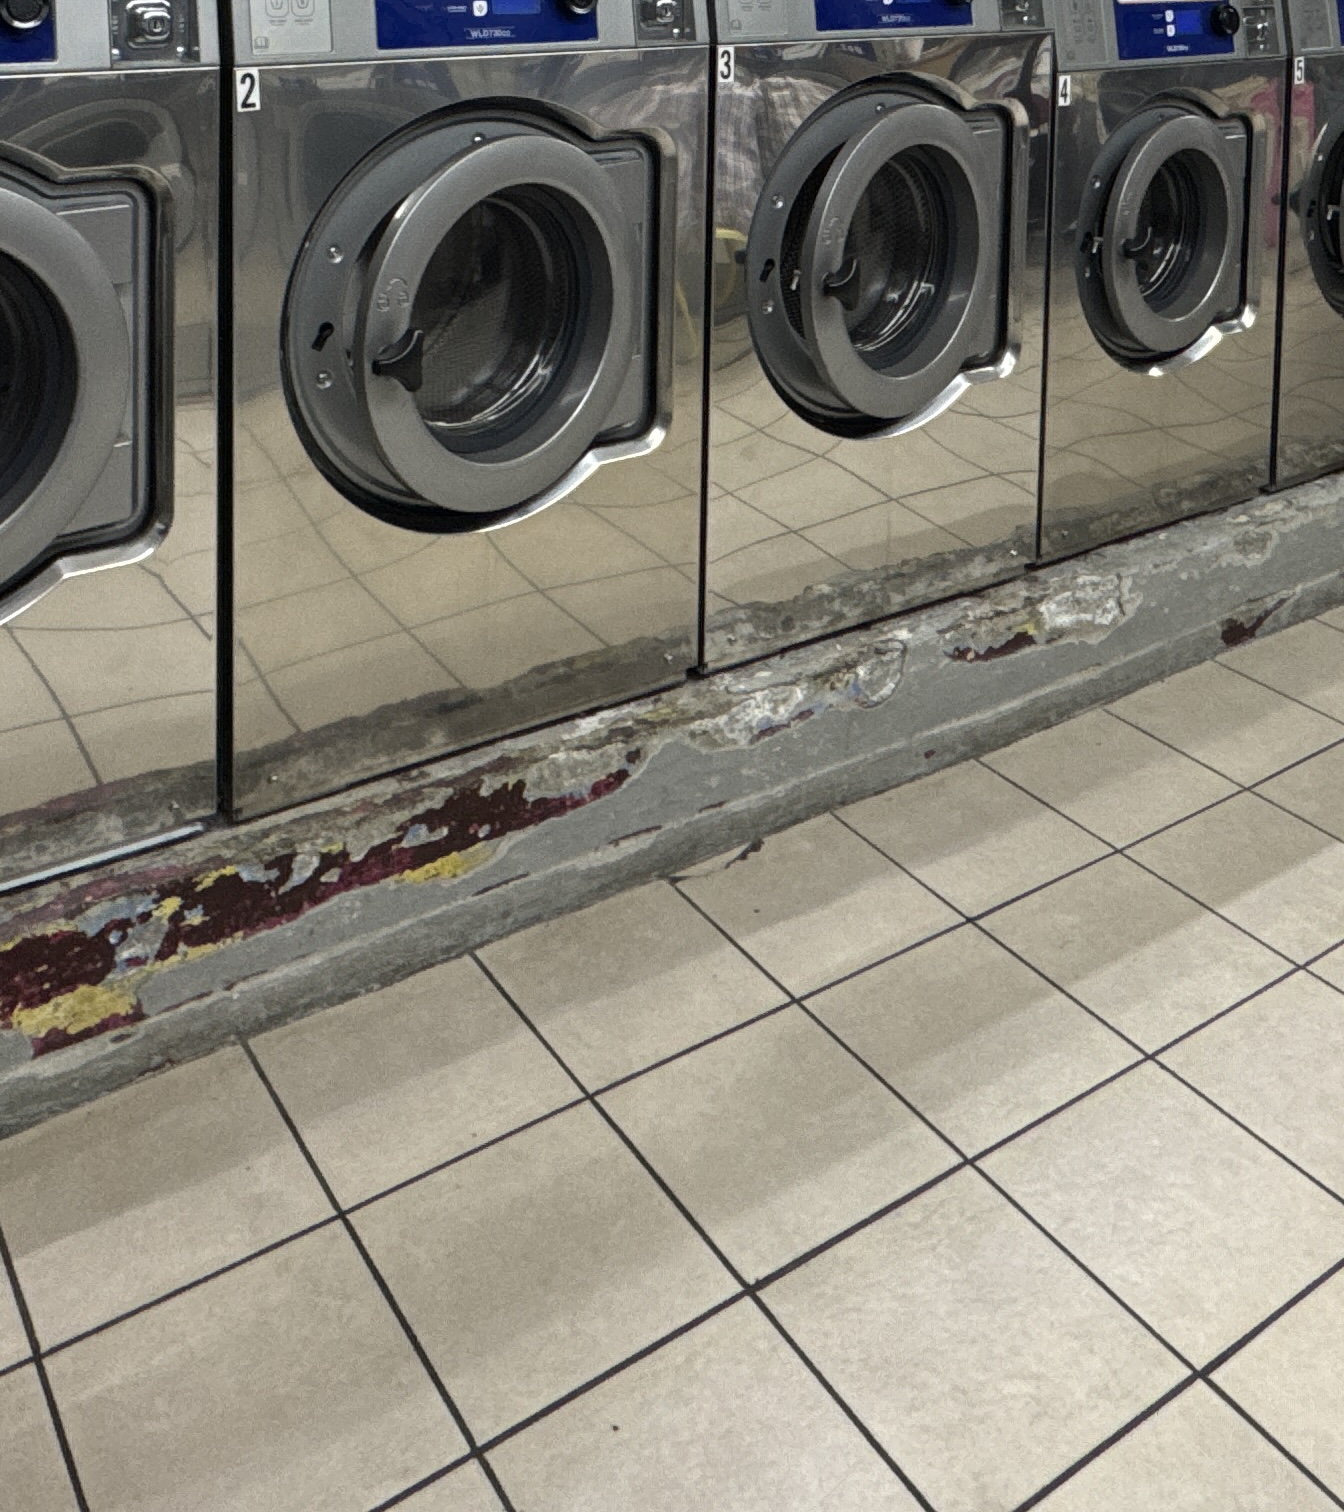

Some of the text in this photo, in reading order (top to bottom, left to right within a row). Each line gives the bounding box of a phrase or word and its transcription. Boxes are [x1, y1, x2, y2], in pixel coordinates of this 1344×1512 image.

[719, 49, 732, 80] 3
[1296, 59, 1304, 83] 5
[240, 72, 257, 109] 2
[1059, 77, 1070, 105] 4
